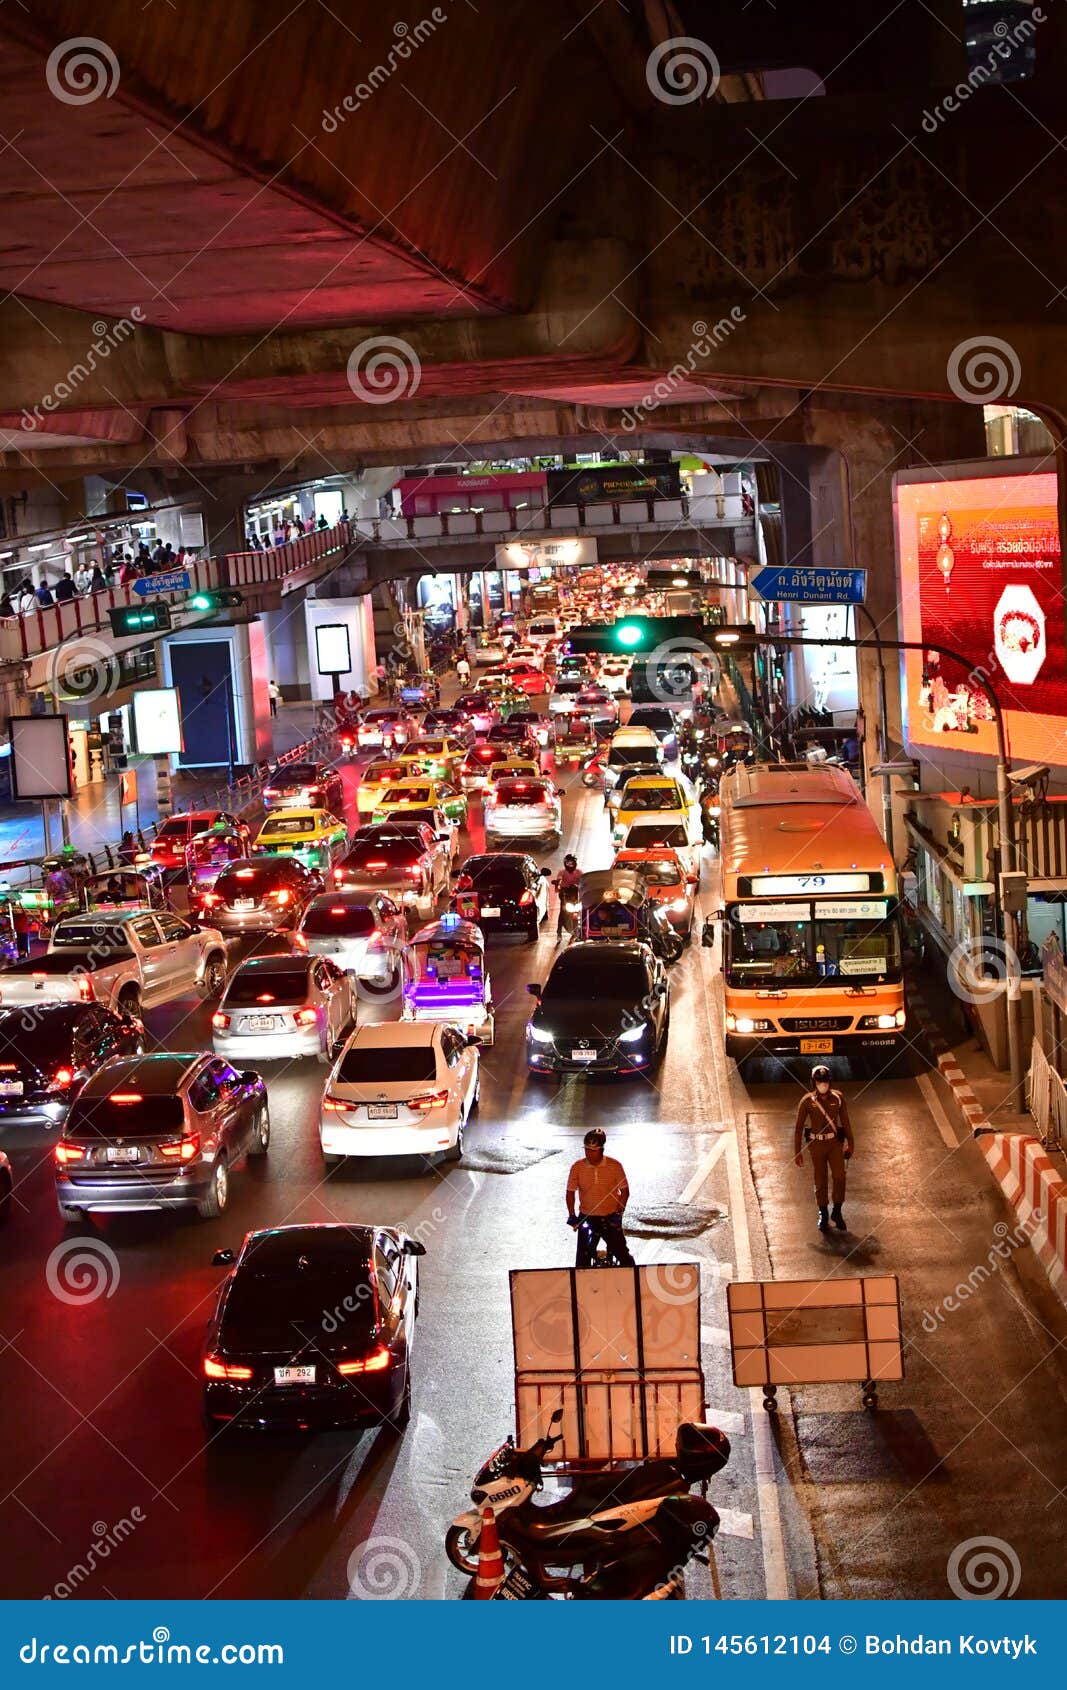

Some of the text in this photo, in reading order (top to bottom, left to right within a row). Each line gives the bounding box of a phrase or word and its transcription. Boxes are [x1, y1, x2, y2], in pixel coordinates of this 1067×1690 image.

[776, 590, 799, 599] Henri
[803, 591, 833, 600] Dunant
[797, 876, 826, 887] 79
[463, 908, 475, 918] 16
[794, 1019, 837, 1029] ISUZU
[296, 1368, 311, 1377] 292
[488, 1485, 521, 1503] 6680
